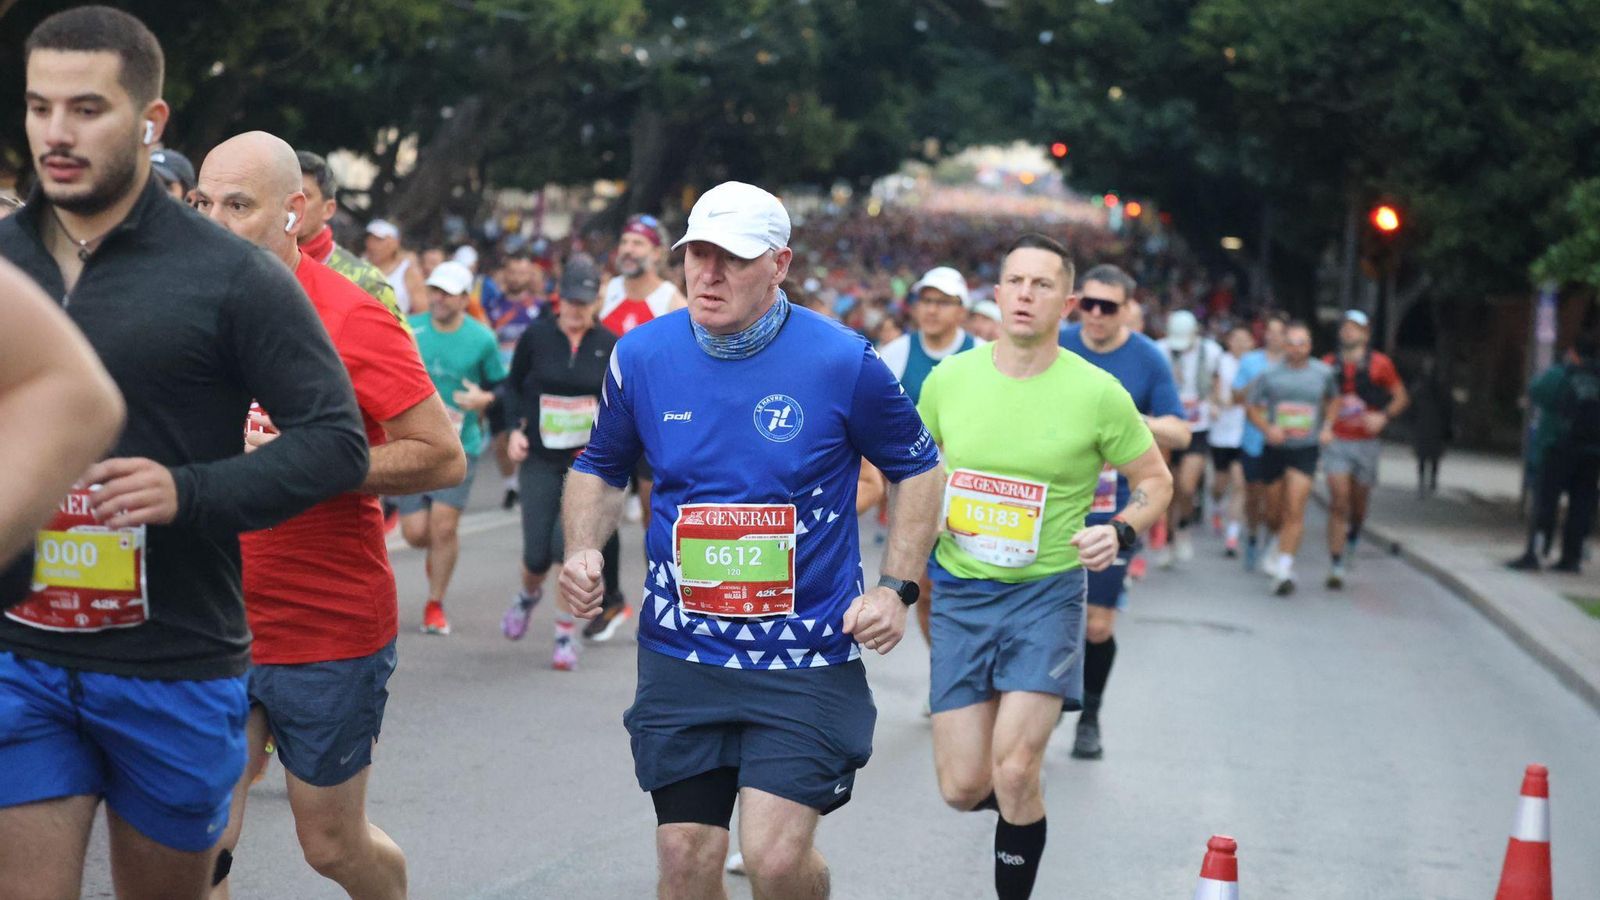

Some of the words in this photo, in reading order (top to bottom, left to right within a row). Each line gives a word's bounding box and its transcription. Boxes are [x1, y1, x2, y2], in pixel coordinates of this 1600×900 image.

[663, 411, 692, 422] poli
[973, 478, 1038, 500] GENERALI
[706, 510, 786, 526] GENERALI
[966, 503, 1019, 528] 16183
[35, 538, 98, 567] 000
[705, 545, 762, 566] 6612
[756, 589, 776, 598] 42K
